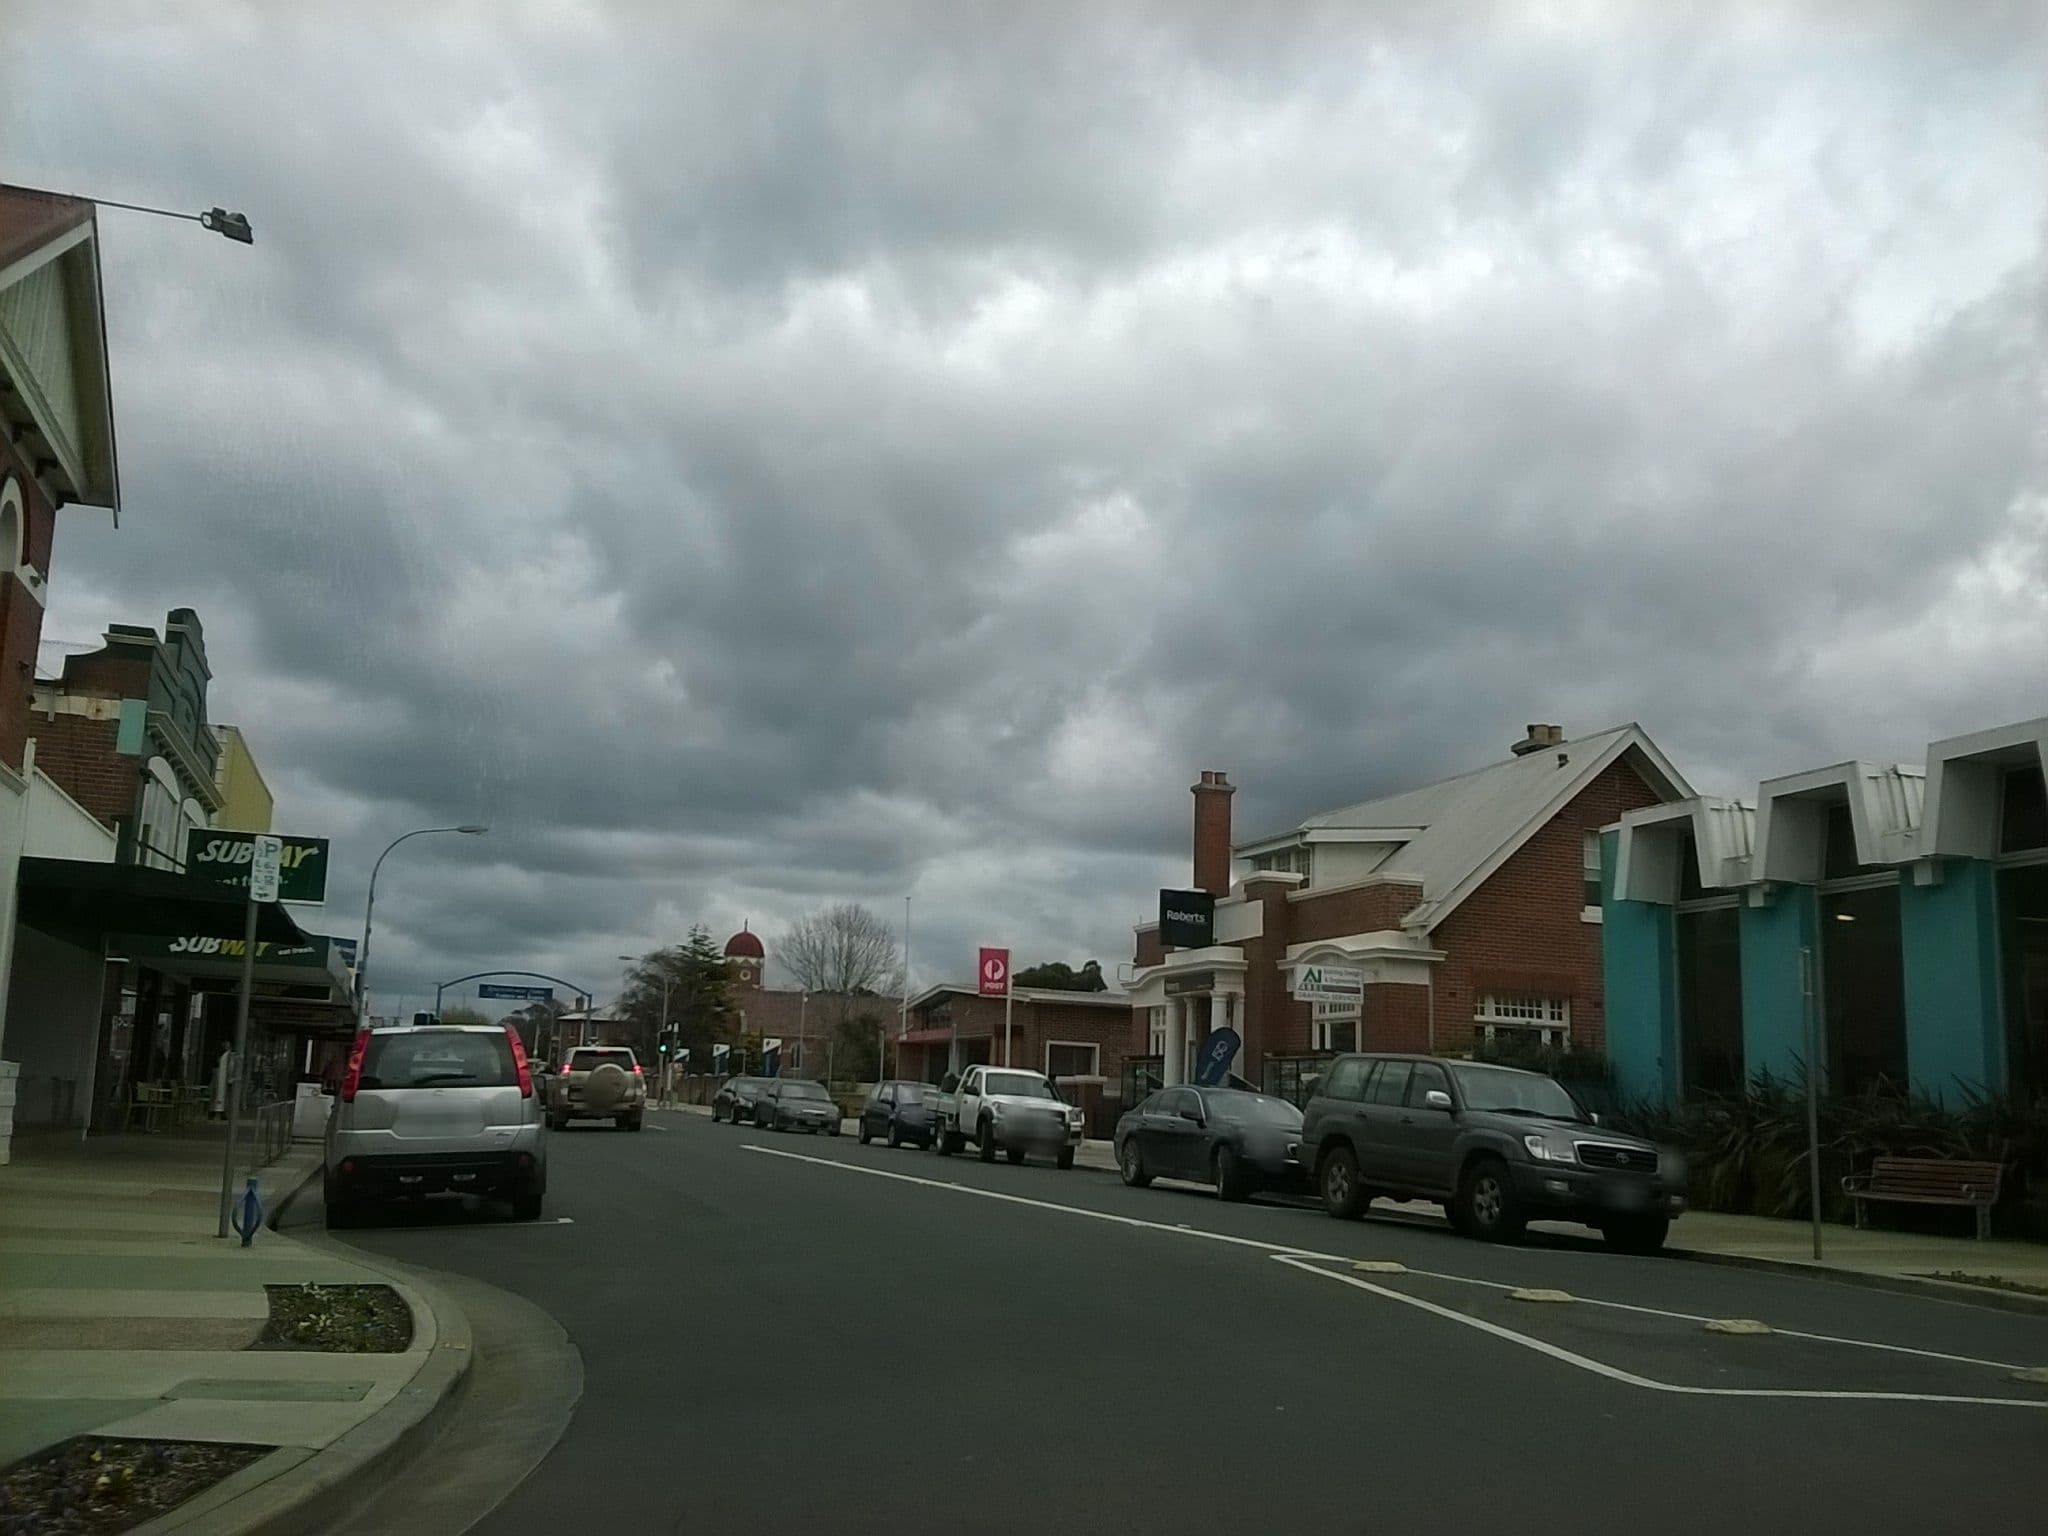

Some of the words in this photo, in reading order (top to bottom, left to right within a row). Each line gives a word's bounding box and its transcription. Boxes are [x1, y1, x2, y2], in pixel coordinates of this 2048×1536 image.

[197, 840, 319, 868] SUBAY
[1166, 910, 1206, 922] Roberts
[168, 936, 270, 957] SUBWY
[984, 981, 1005, 989] POST
